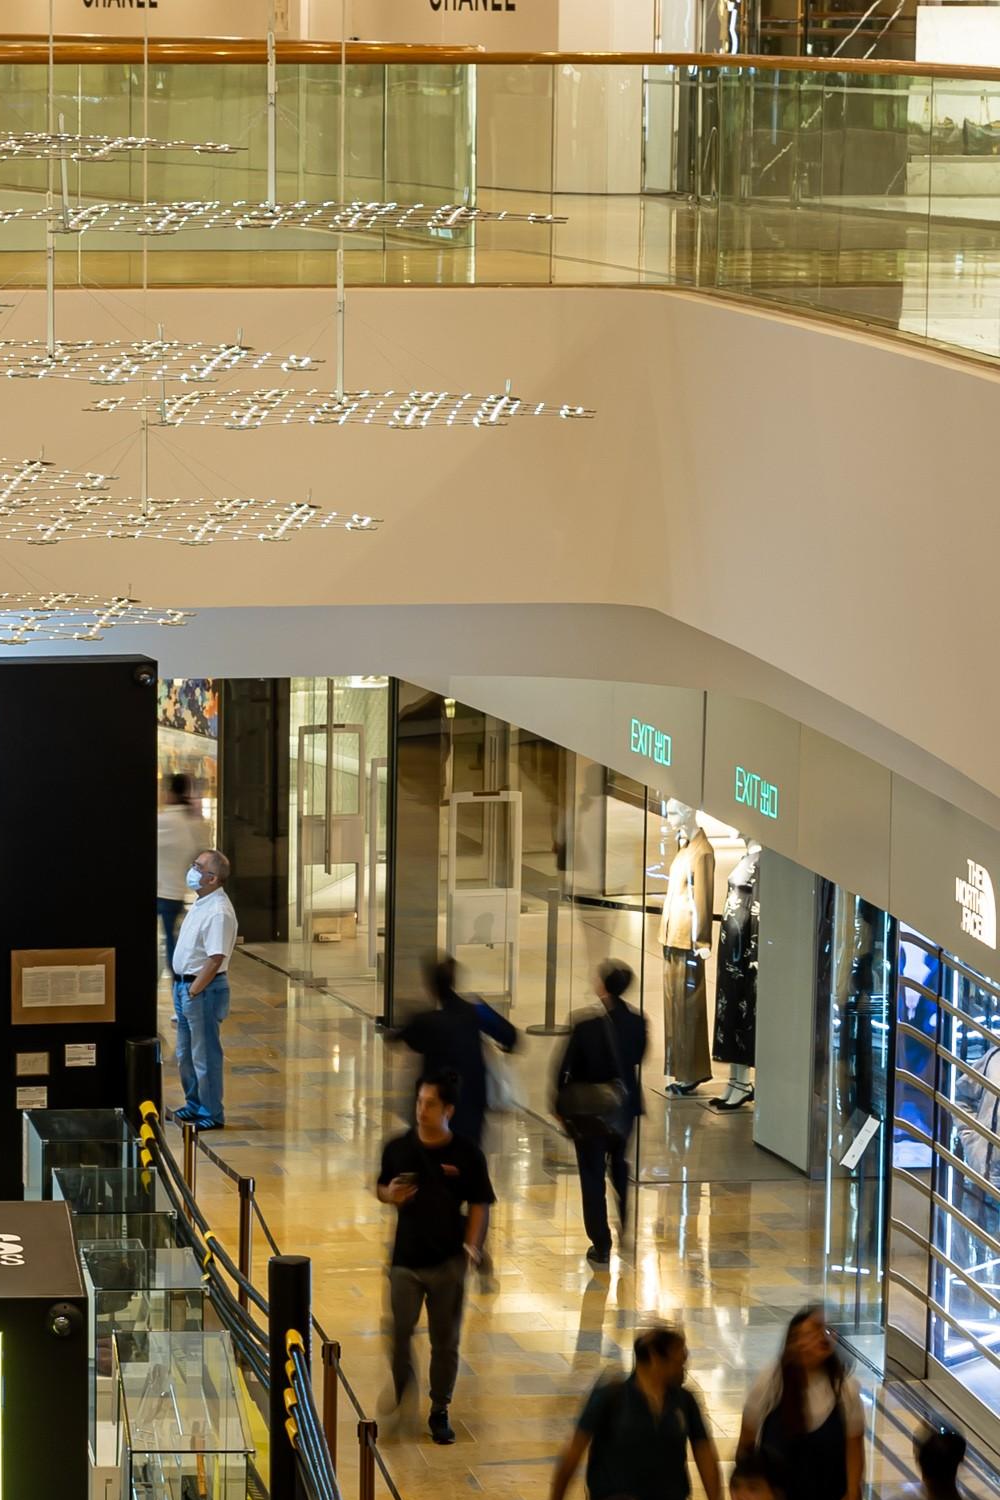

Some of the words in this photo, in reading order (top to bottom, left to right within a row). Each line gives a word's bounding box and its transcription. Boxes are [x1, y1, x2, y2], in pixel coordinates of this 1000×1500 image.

[630, 718, 655, 758] EXIT
[654, 730, 672, 767] 出口
[735, 766, 761, 809] EXIT
[760, 780, 779, 819] 出口
[967, 858, 984, 892] THE
